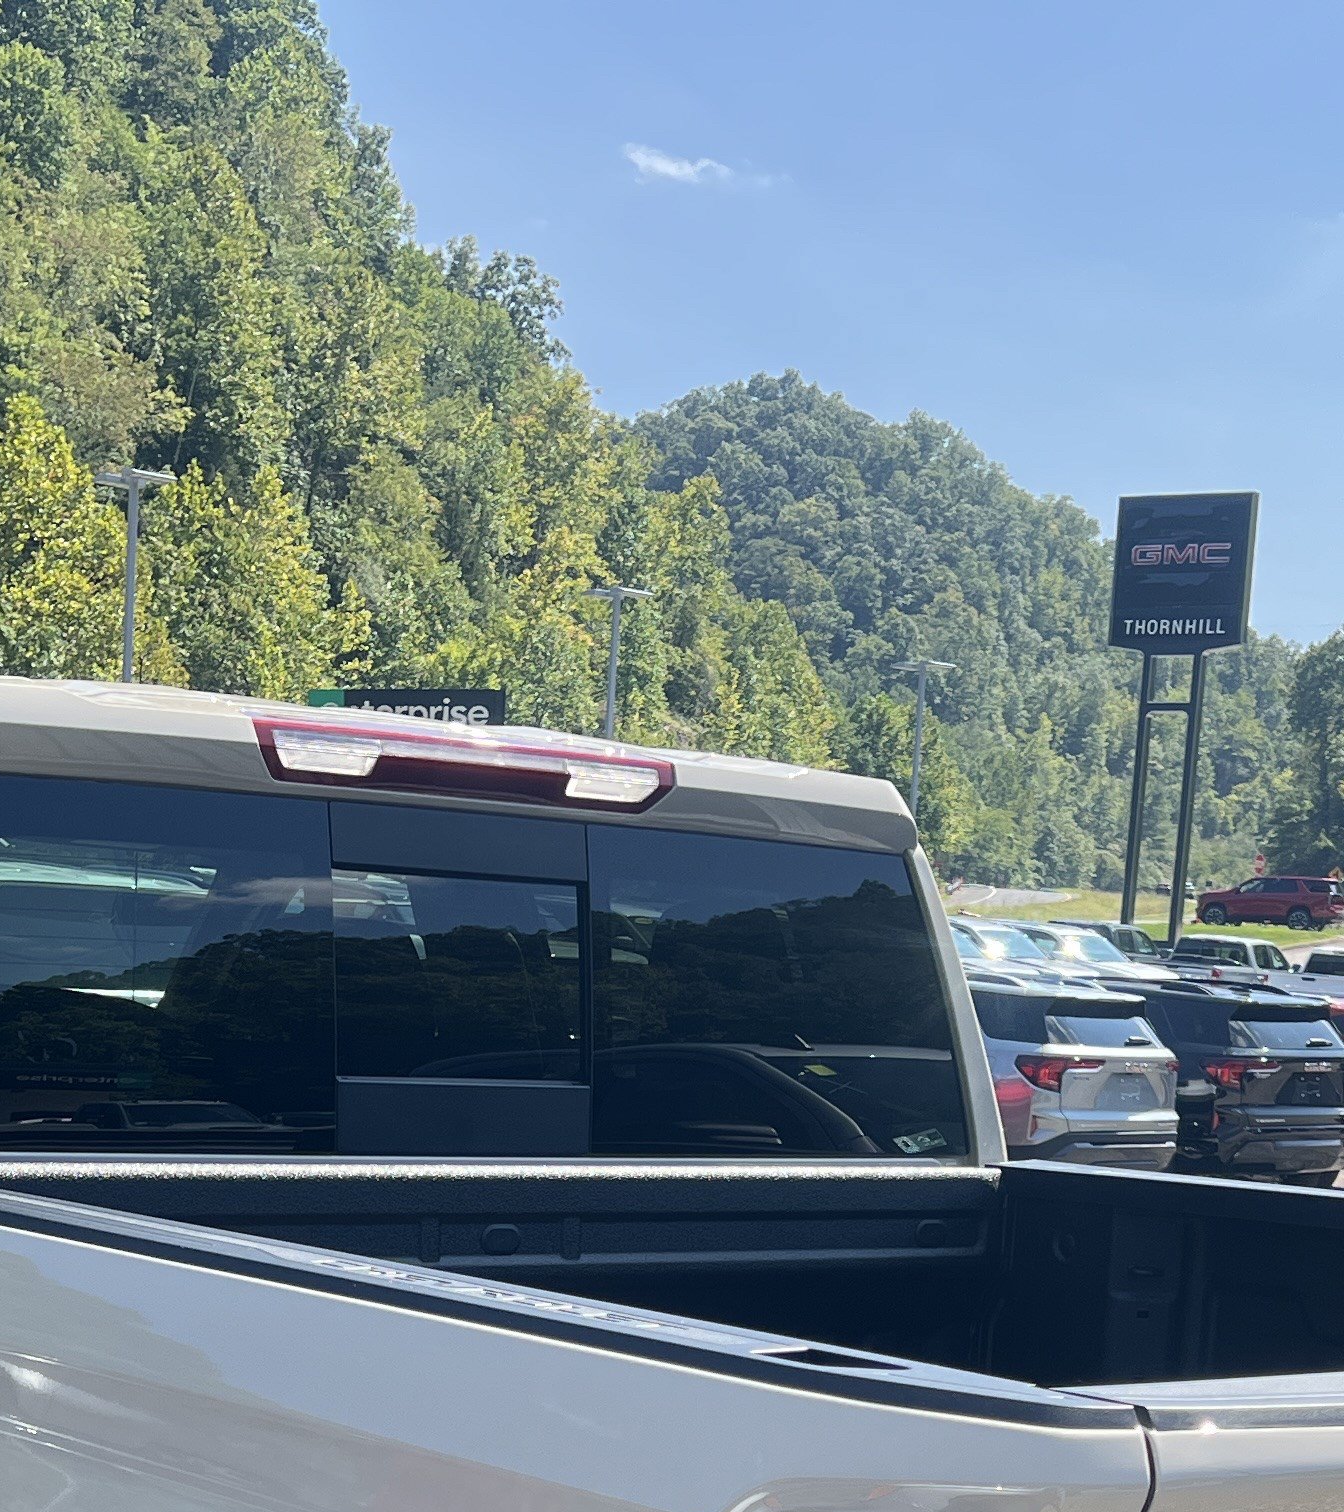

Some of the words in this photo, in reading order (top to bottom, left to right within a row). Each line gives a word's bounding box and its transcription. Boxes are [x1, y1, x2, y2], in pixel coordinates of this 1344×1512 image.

[1131, 542, 1232, 566] GMC
[1123, 618, 1226, 635] THORNHILL
[322, 697, 490, 726] rprise
